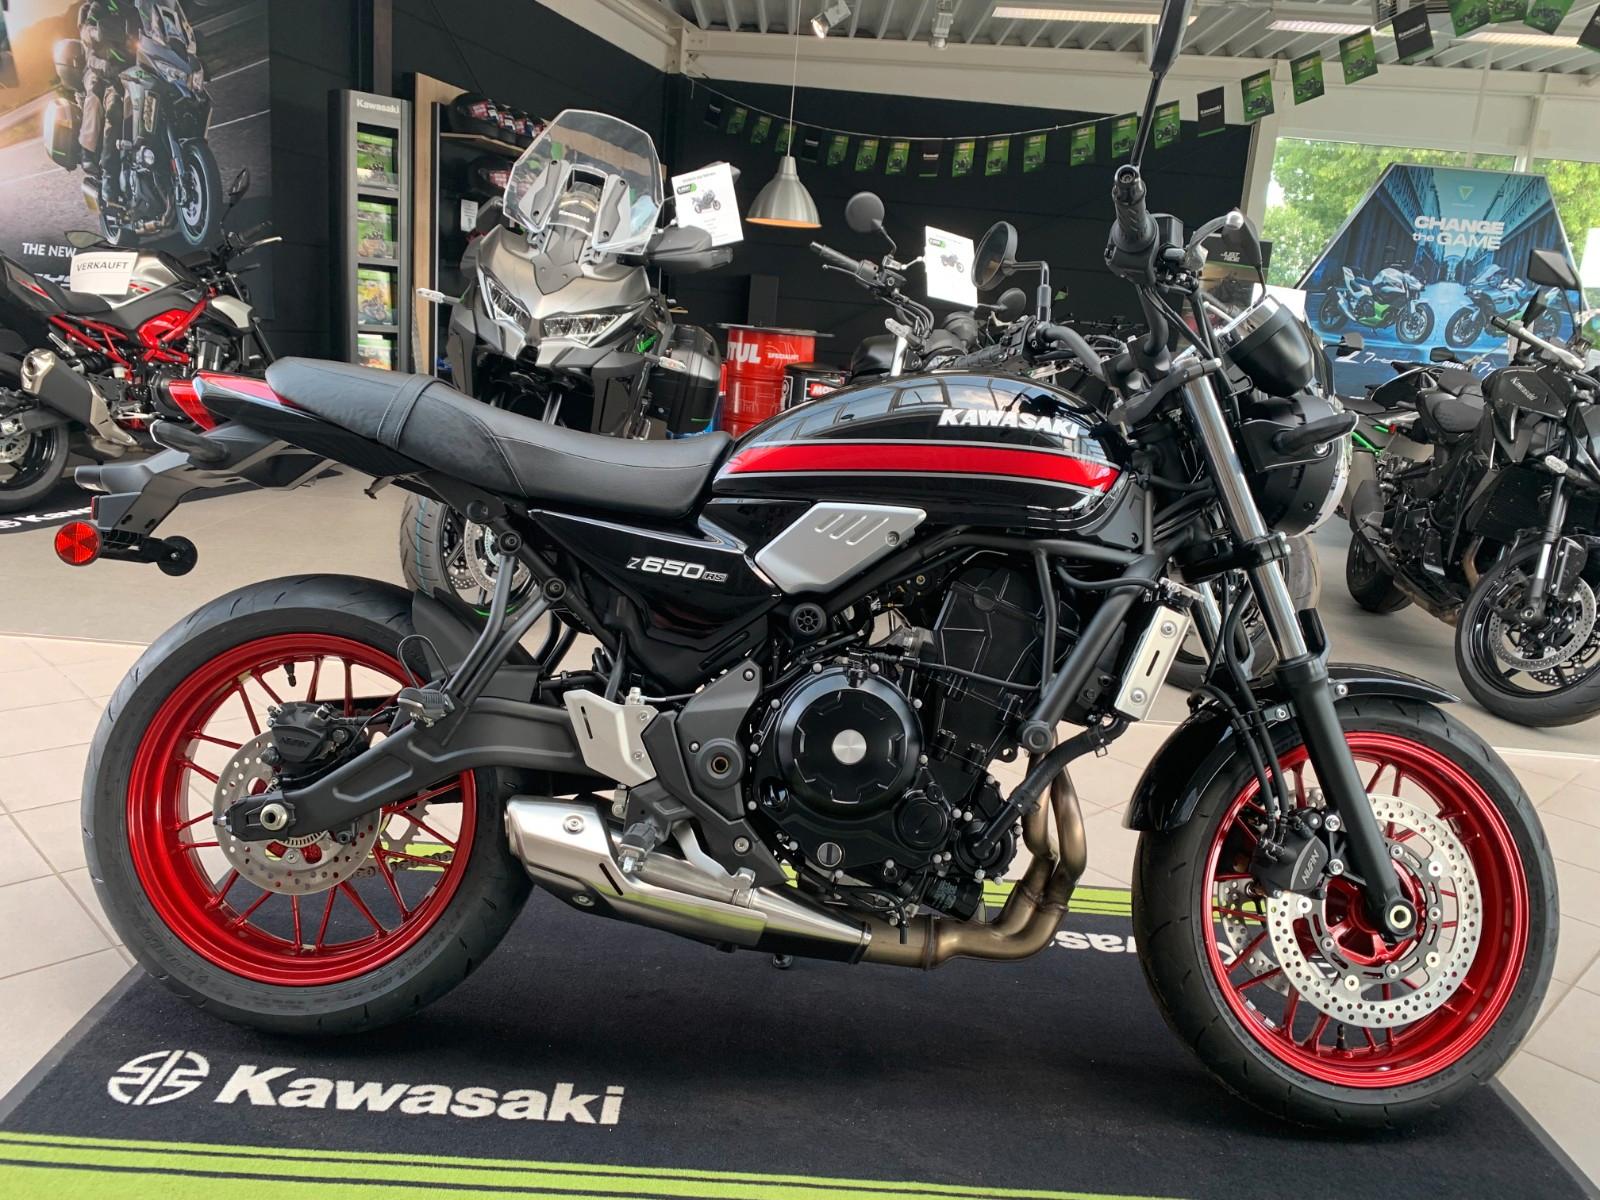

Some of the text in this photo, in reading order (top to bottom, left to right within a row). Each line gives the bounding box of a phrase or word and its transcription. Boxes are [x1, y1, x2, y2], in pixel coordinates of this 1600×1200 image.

[356, 98, 400, 114] Kawasaki
[1414, 215, 1505, 235] CHANGE
[22, 242, 77, 258] THE NEW
[1412, 231, 1503, 250] the GAME
[76, 261, 129, 272] VERKAUFT
[937, 408, 1080, 438] KAWASAKI
[213, 1064, 626, 1126] Kawasaki
